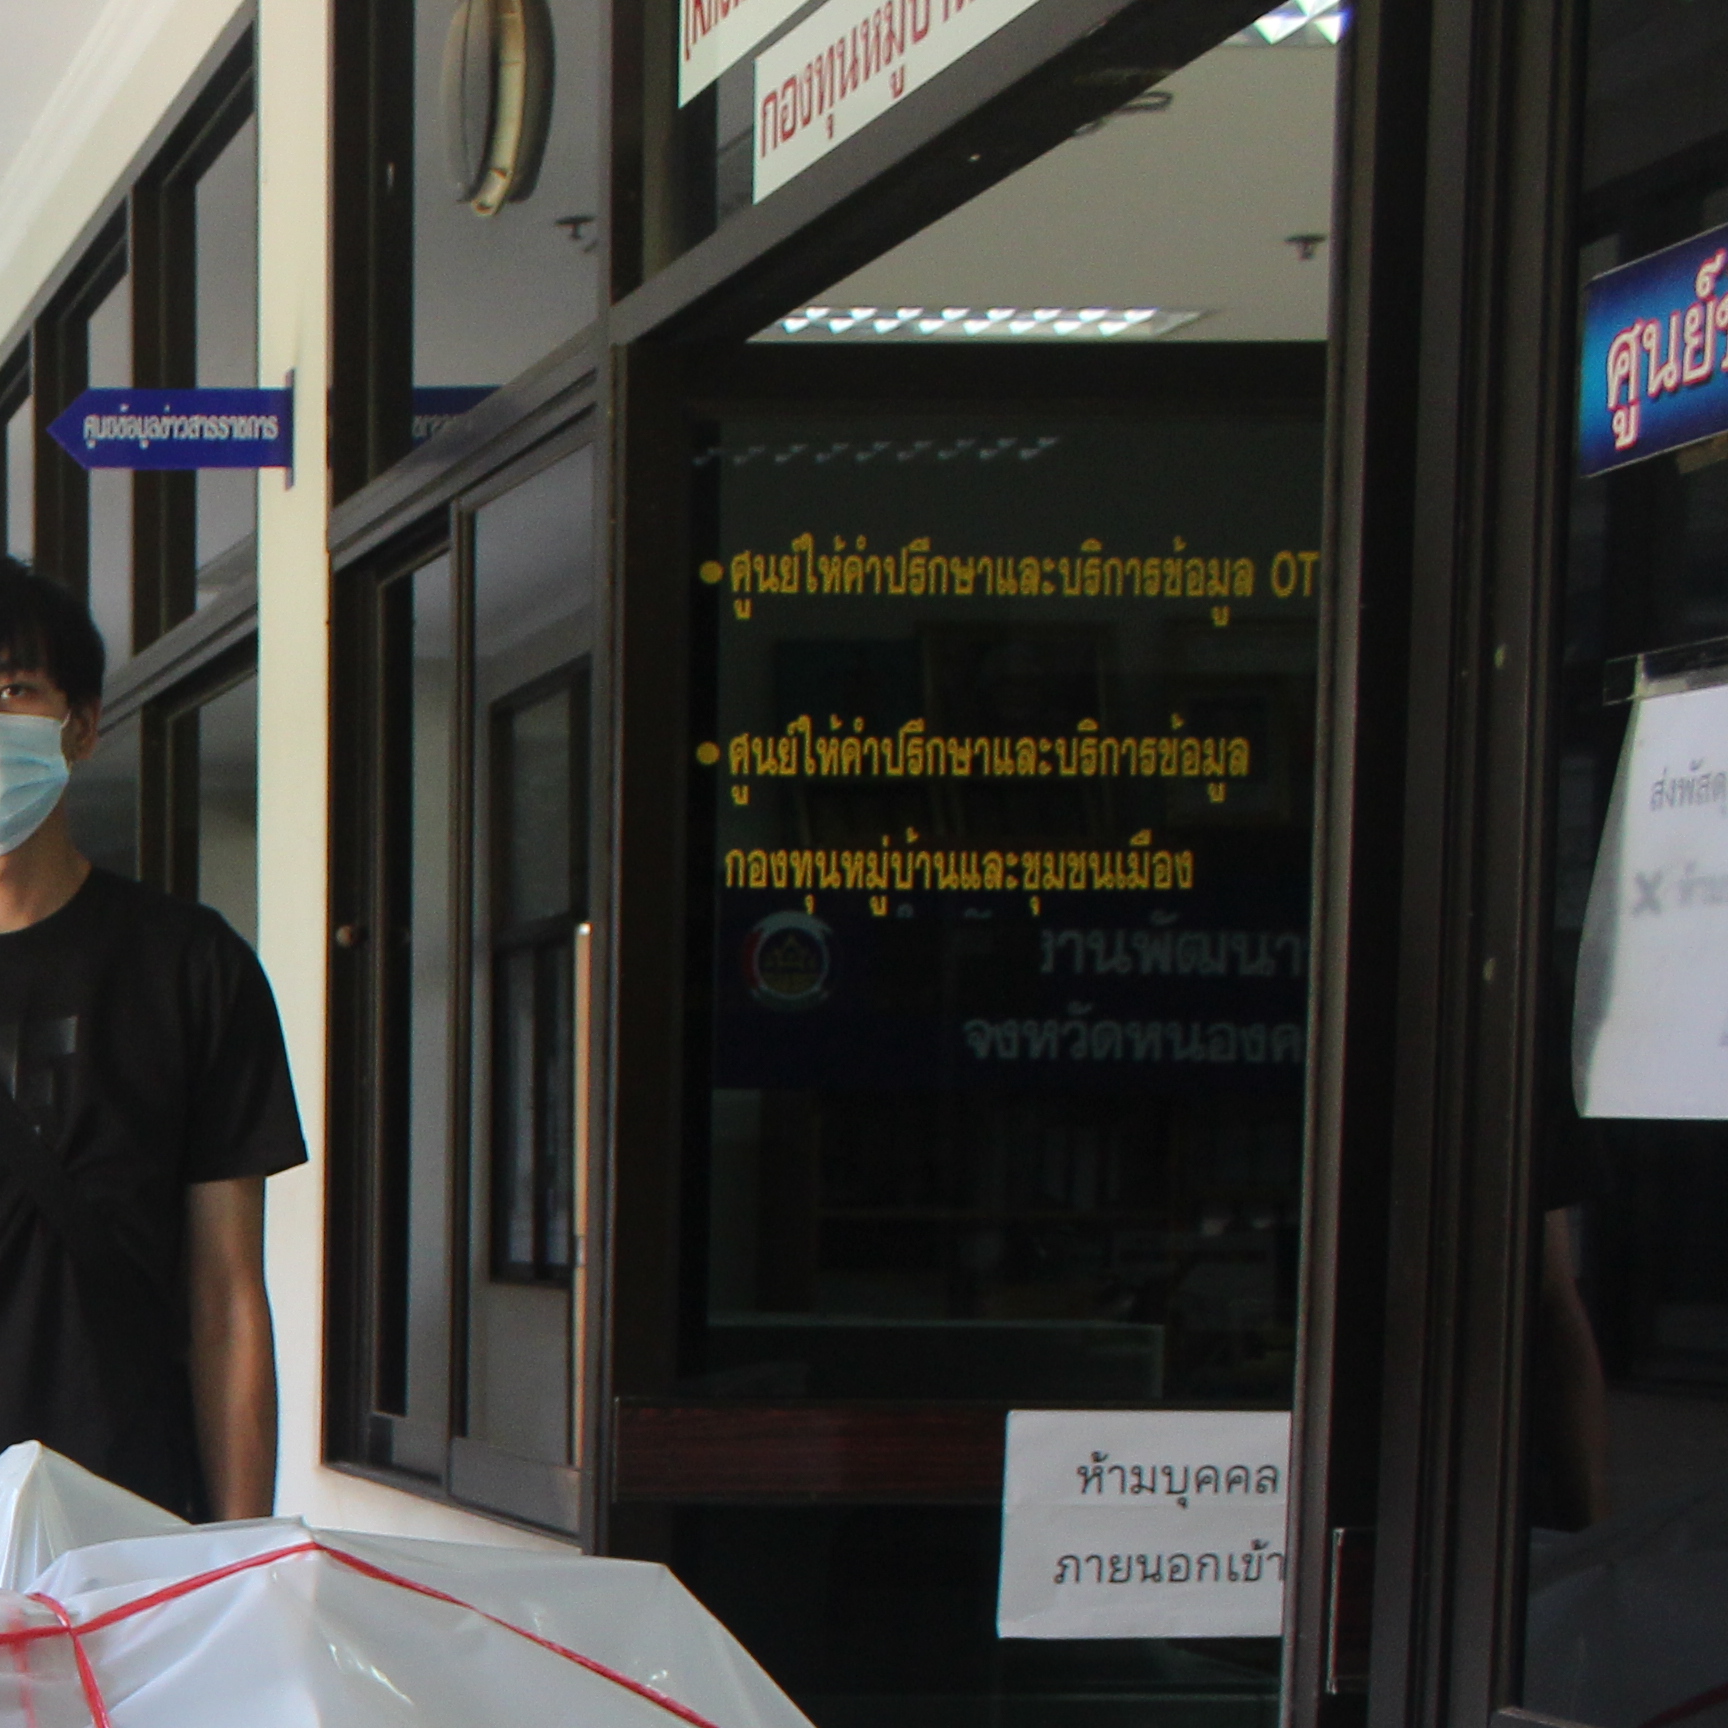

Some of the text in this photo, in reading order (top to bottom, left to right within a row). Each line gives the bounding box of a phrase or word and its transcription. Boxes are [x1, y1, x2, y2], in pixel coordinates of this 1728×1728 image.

[1076, 1450, 1280, 1510] ห้ามบุคคล
[1052, 1538, 1286, 1585] ภายนอกเข้า
